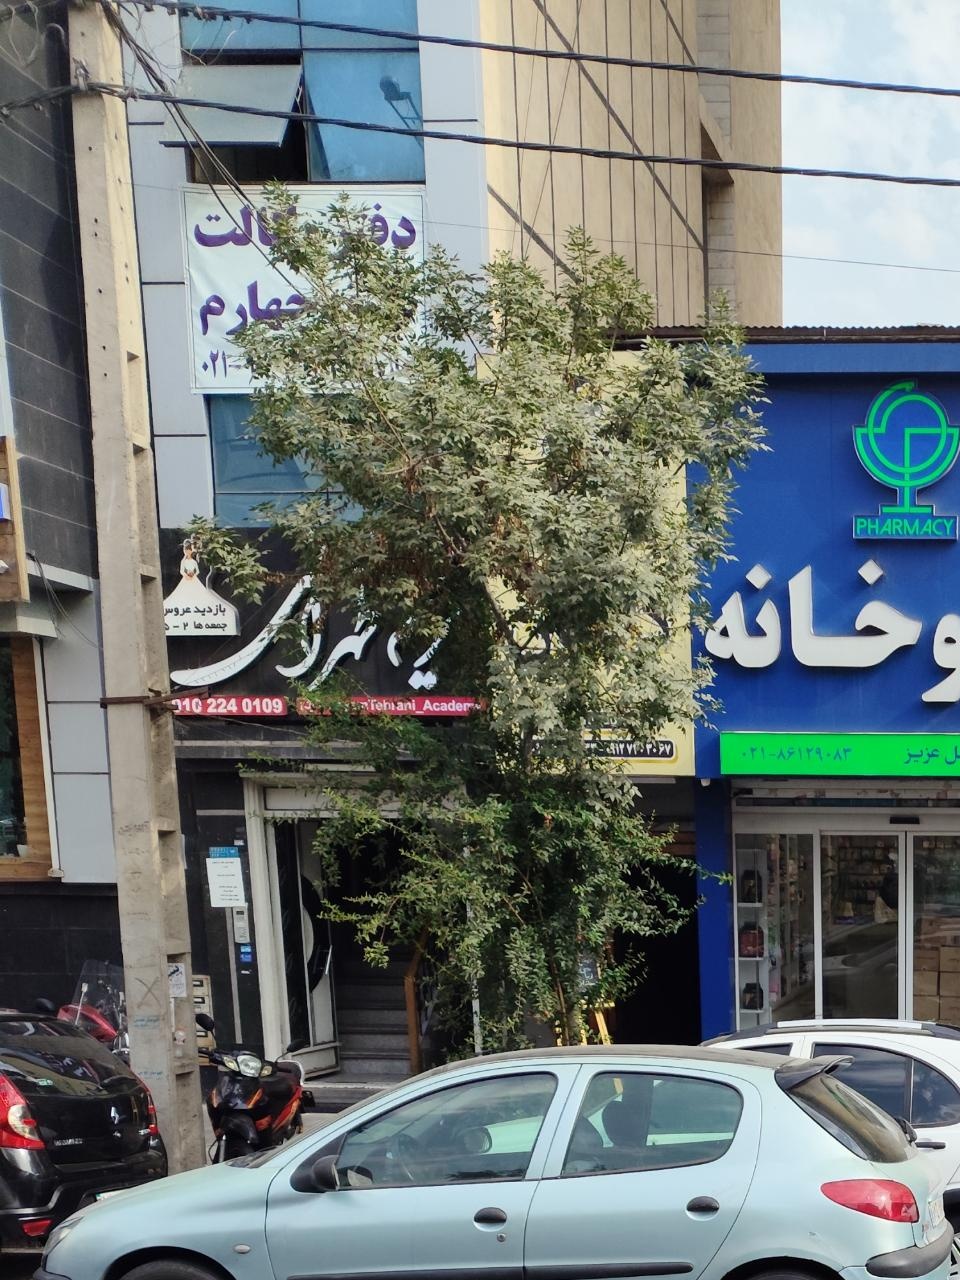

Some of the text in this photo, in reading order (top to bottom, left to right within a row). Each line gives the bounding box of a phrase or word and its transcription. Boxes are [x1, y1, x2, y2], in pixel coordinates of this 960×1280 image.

[856, 518, 955, 537] PHARMACY
[193, 603, 226, 617] بازدید
[205, 623, 228, 632] جمعه
[206, 697, 238, 713] 224
[242, 697, 283, 713] 0109
[903, 746, 940, 764] عزیز
